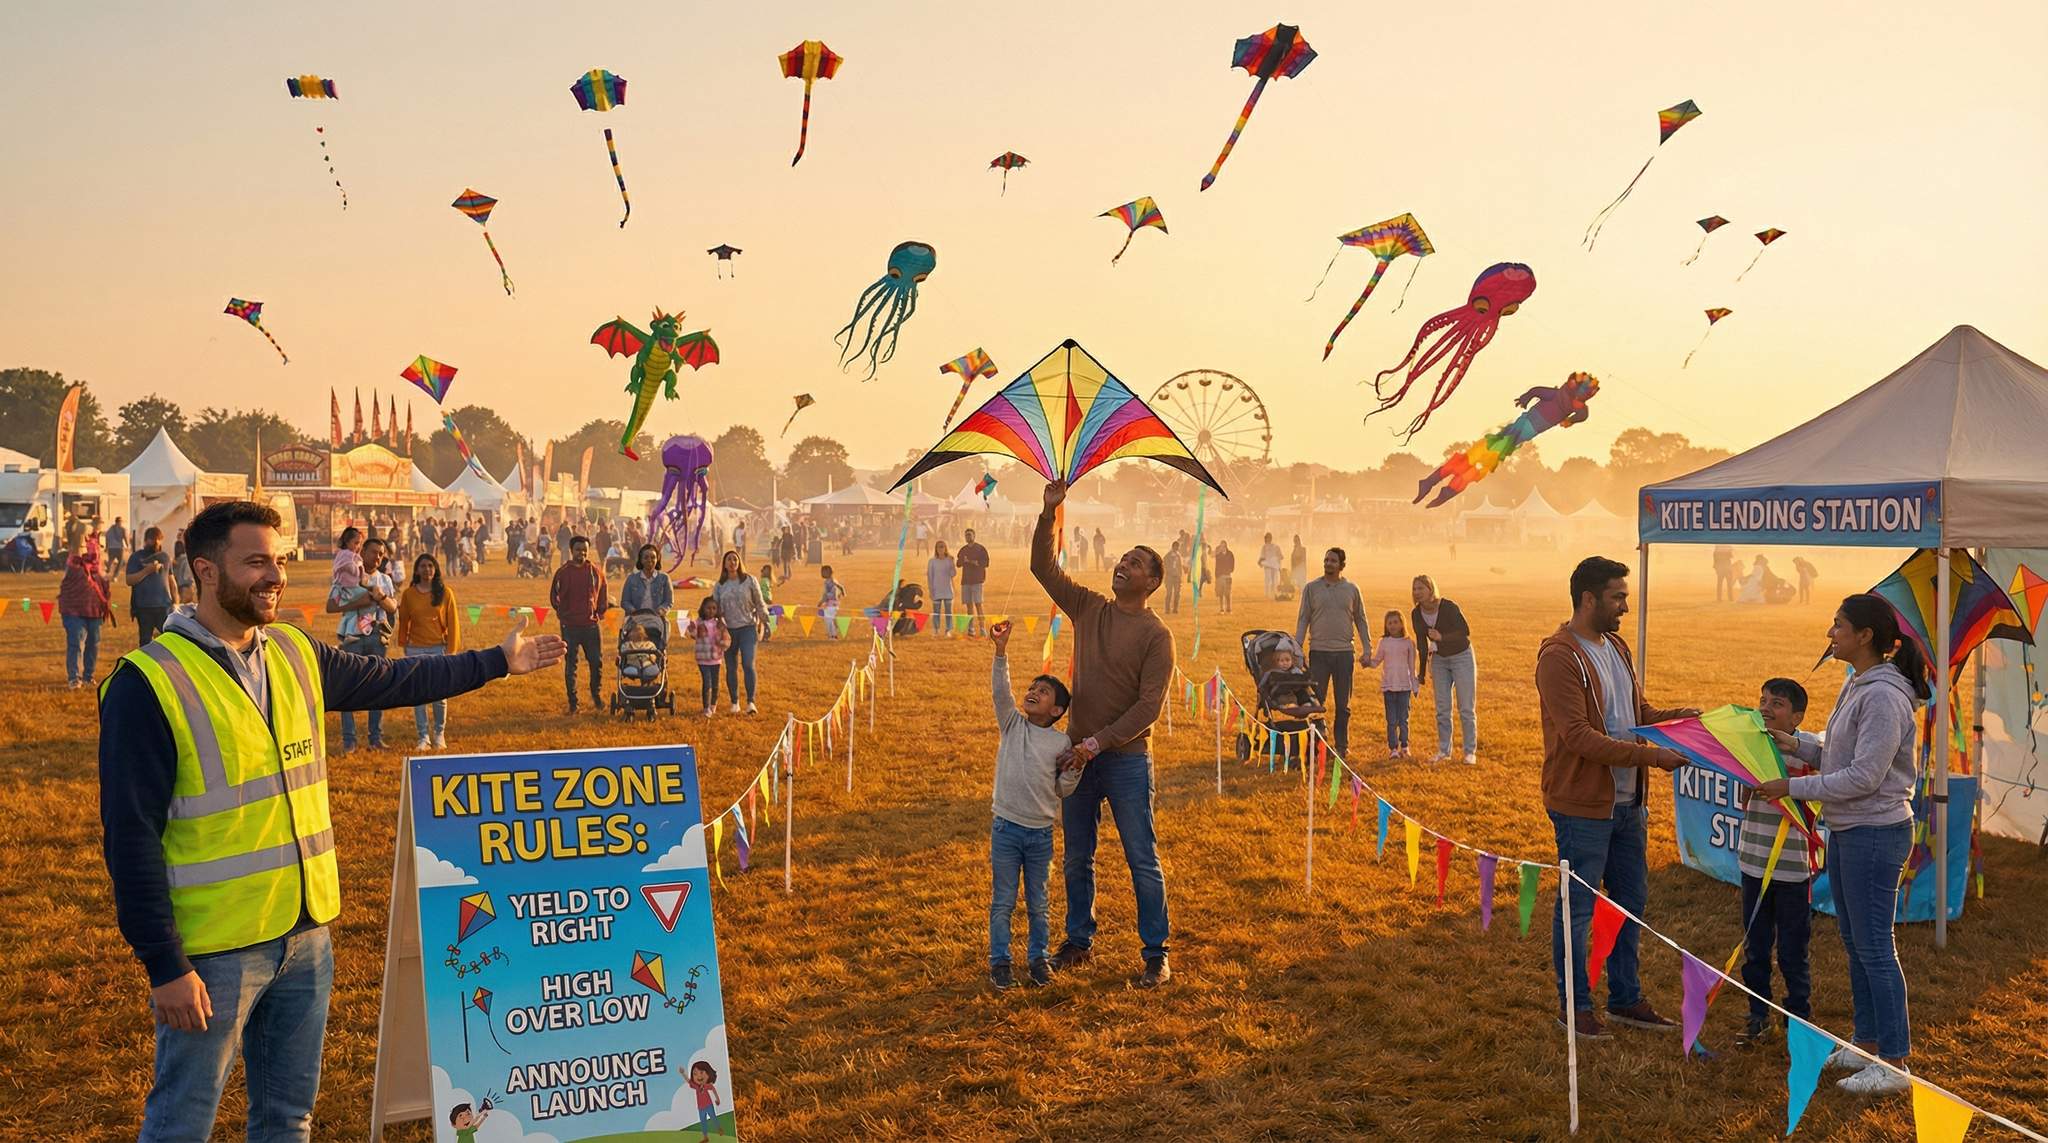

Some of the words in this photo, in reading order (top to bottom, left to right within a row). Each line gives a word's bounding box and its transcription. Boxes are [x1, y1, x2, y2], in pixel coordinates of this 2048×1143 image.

[1661, 500, 1704, 530] KITE
[1709, 499, 1806, 530] LENDING
[1812, 497, 1921, 531] STATION
[283, 739, 312, 760] STAFF
[431, 770, 542, 817] KITE
[553, 764, 684, 810] ZONE
[1680, 766, 1728, 806] KITE
[479, 814, 648, 863] RULES:
[510, 890, 589, 919] YIELD
[597, 888, 630, 912] TO
[532, 916, 614, 946] RIGHT
[542, 970, 612, 1001] HIGH
[506, 1002, 582, 1034] OVER
[589, 996, 649, 1025] LOW
[507, 1049, 665, 1092] ANNOUNCE
[532, 1081, 646, 1119] LAUNCH
